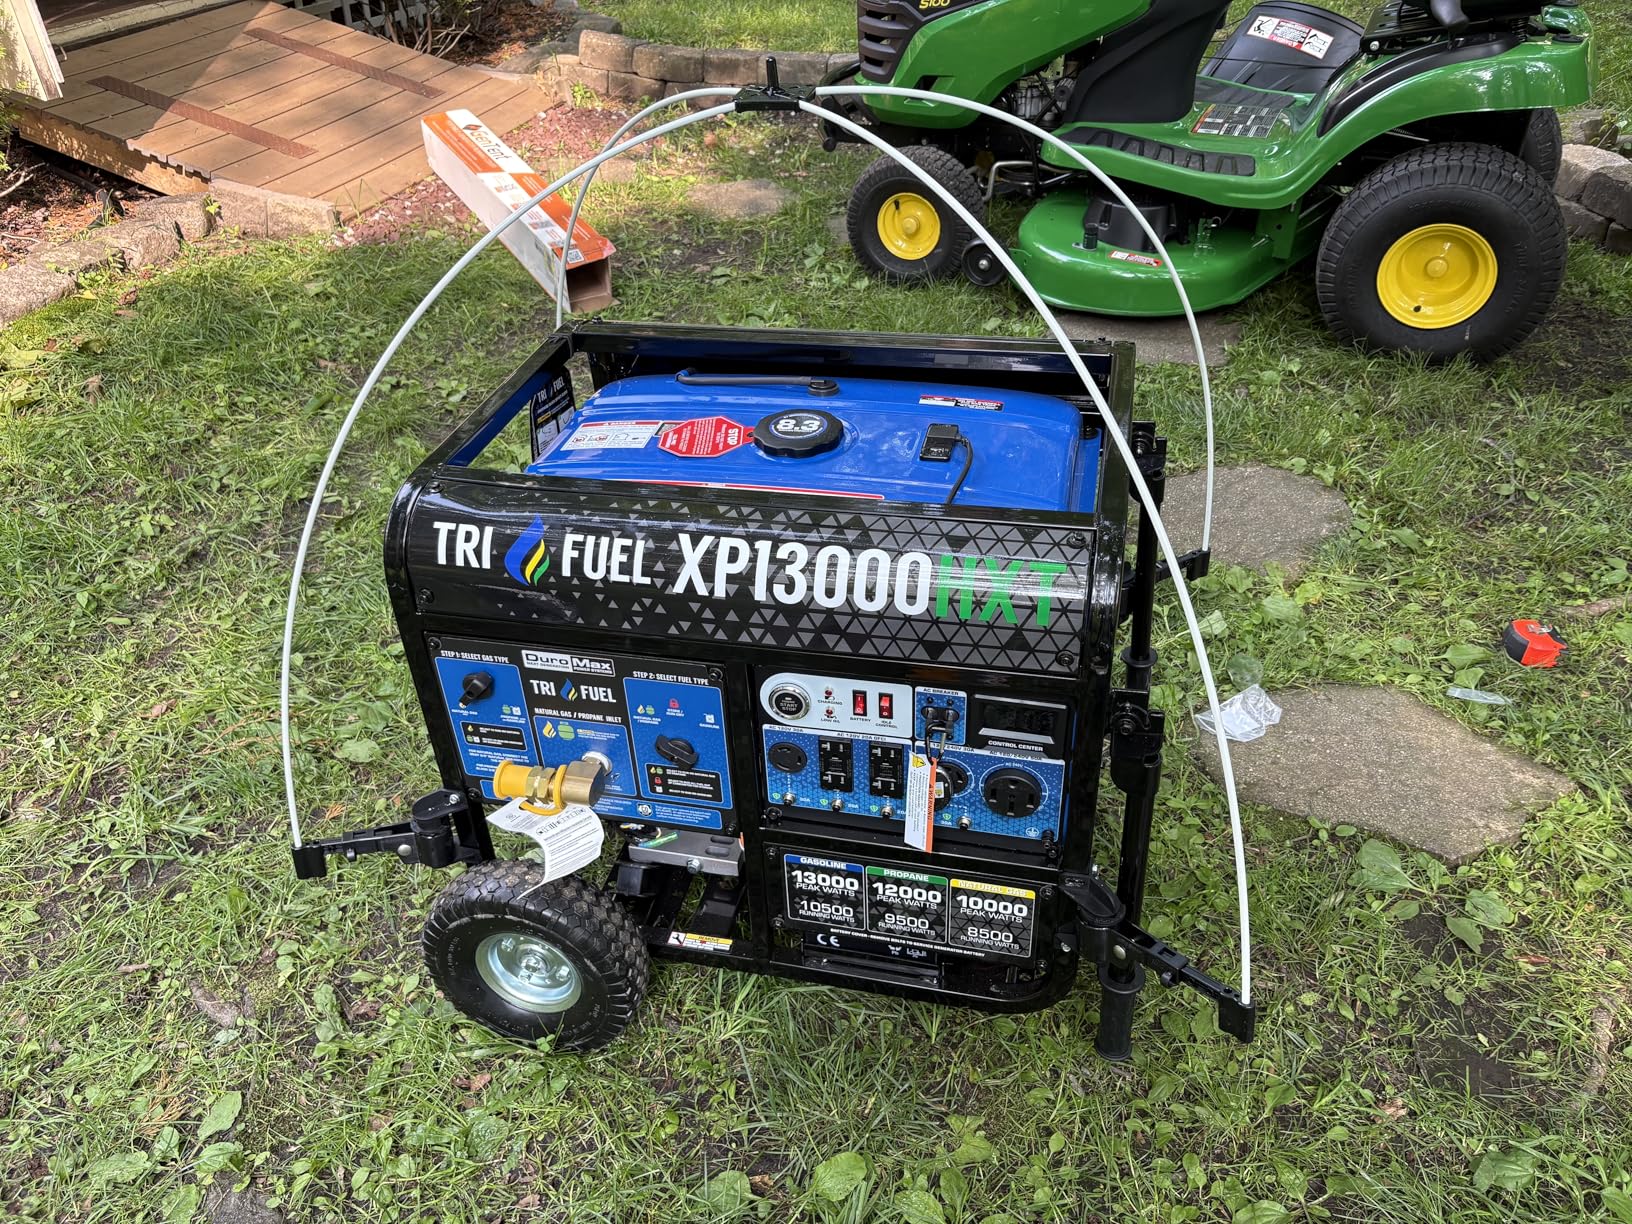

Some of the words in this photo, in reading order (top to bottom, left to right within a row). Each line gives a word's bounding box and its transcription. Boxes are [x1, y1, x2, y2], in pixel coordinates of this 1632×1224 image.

[537, 388, 548, 402] TRI
[553, 376, 566, 392] FUEL
[776, 418, 822, 431] 8.3
[727, 428, 738, 445] STOP
[433, 521, 494, 569] TRI
[562, 533, 651, 585] FUEL
[673, 533, 1067, 626] XP13000HXT
[460, 652, 480, 660] SELECT
[526, 654, 611, 670] DuroMax
[633, 671, 648, 679] STEP
[656, 674, 677, 682] SELECT
[678, 676, 693, 684] FUEL
[693, 677, 709, 686] TYPE
[530, 680, 556, 696] TRI
[580, 685, 617, 702] FUEL
[534, 708, 560, 716] NATURAL
[578, 712, 604, 721] PROPANE
[605, 715, 622, 723] INLET
[988, 740, 1017, 749] CONTROL
[1018, 743, 1044, 752] CENTER
[800, 857, 847, 869] GASOLINE
[791, 870, 859, 891] 13000
[884, 869, 929, 882] PROPANE
[796, 882, 820, 892] PEAK
[822, 886, 855, 897] WATTS
[872, 882, 942, 904] 12000
[959, 880, 1003, 893] NATURAL
[1007, 887, 1027, 896] GAS
[800, 901, 854, 917] 10500
[877, 895, 902, 904] PEAK
[904, 898, 938, 910] WATTS
[956, 895, 1028, 917] 10000
[799, 909, 831, 919] RUNNING
[831, 913, 855, 923] WATTS
[884, 913, 929, 929] 9500
[960, 907, 986, 917] PEAK
[988, 912, 1022, 923] WATTS
[878, 922, 910, 932] RUNNING
[911, 926, 935, 936] WATTS
[967, 926, 1013, 943] 8500
[816, 934, 840, 947] CE
[960, 935, 993, 946] RUNNING
[994, 940, 1020, 950] WATTS
[934, 945, 963, 953] GENERATOR
